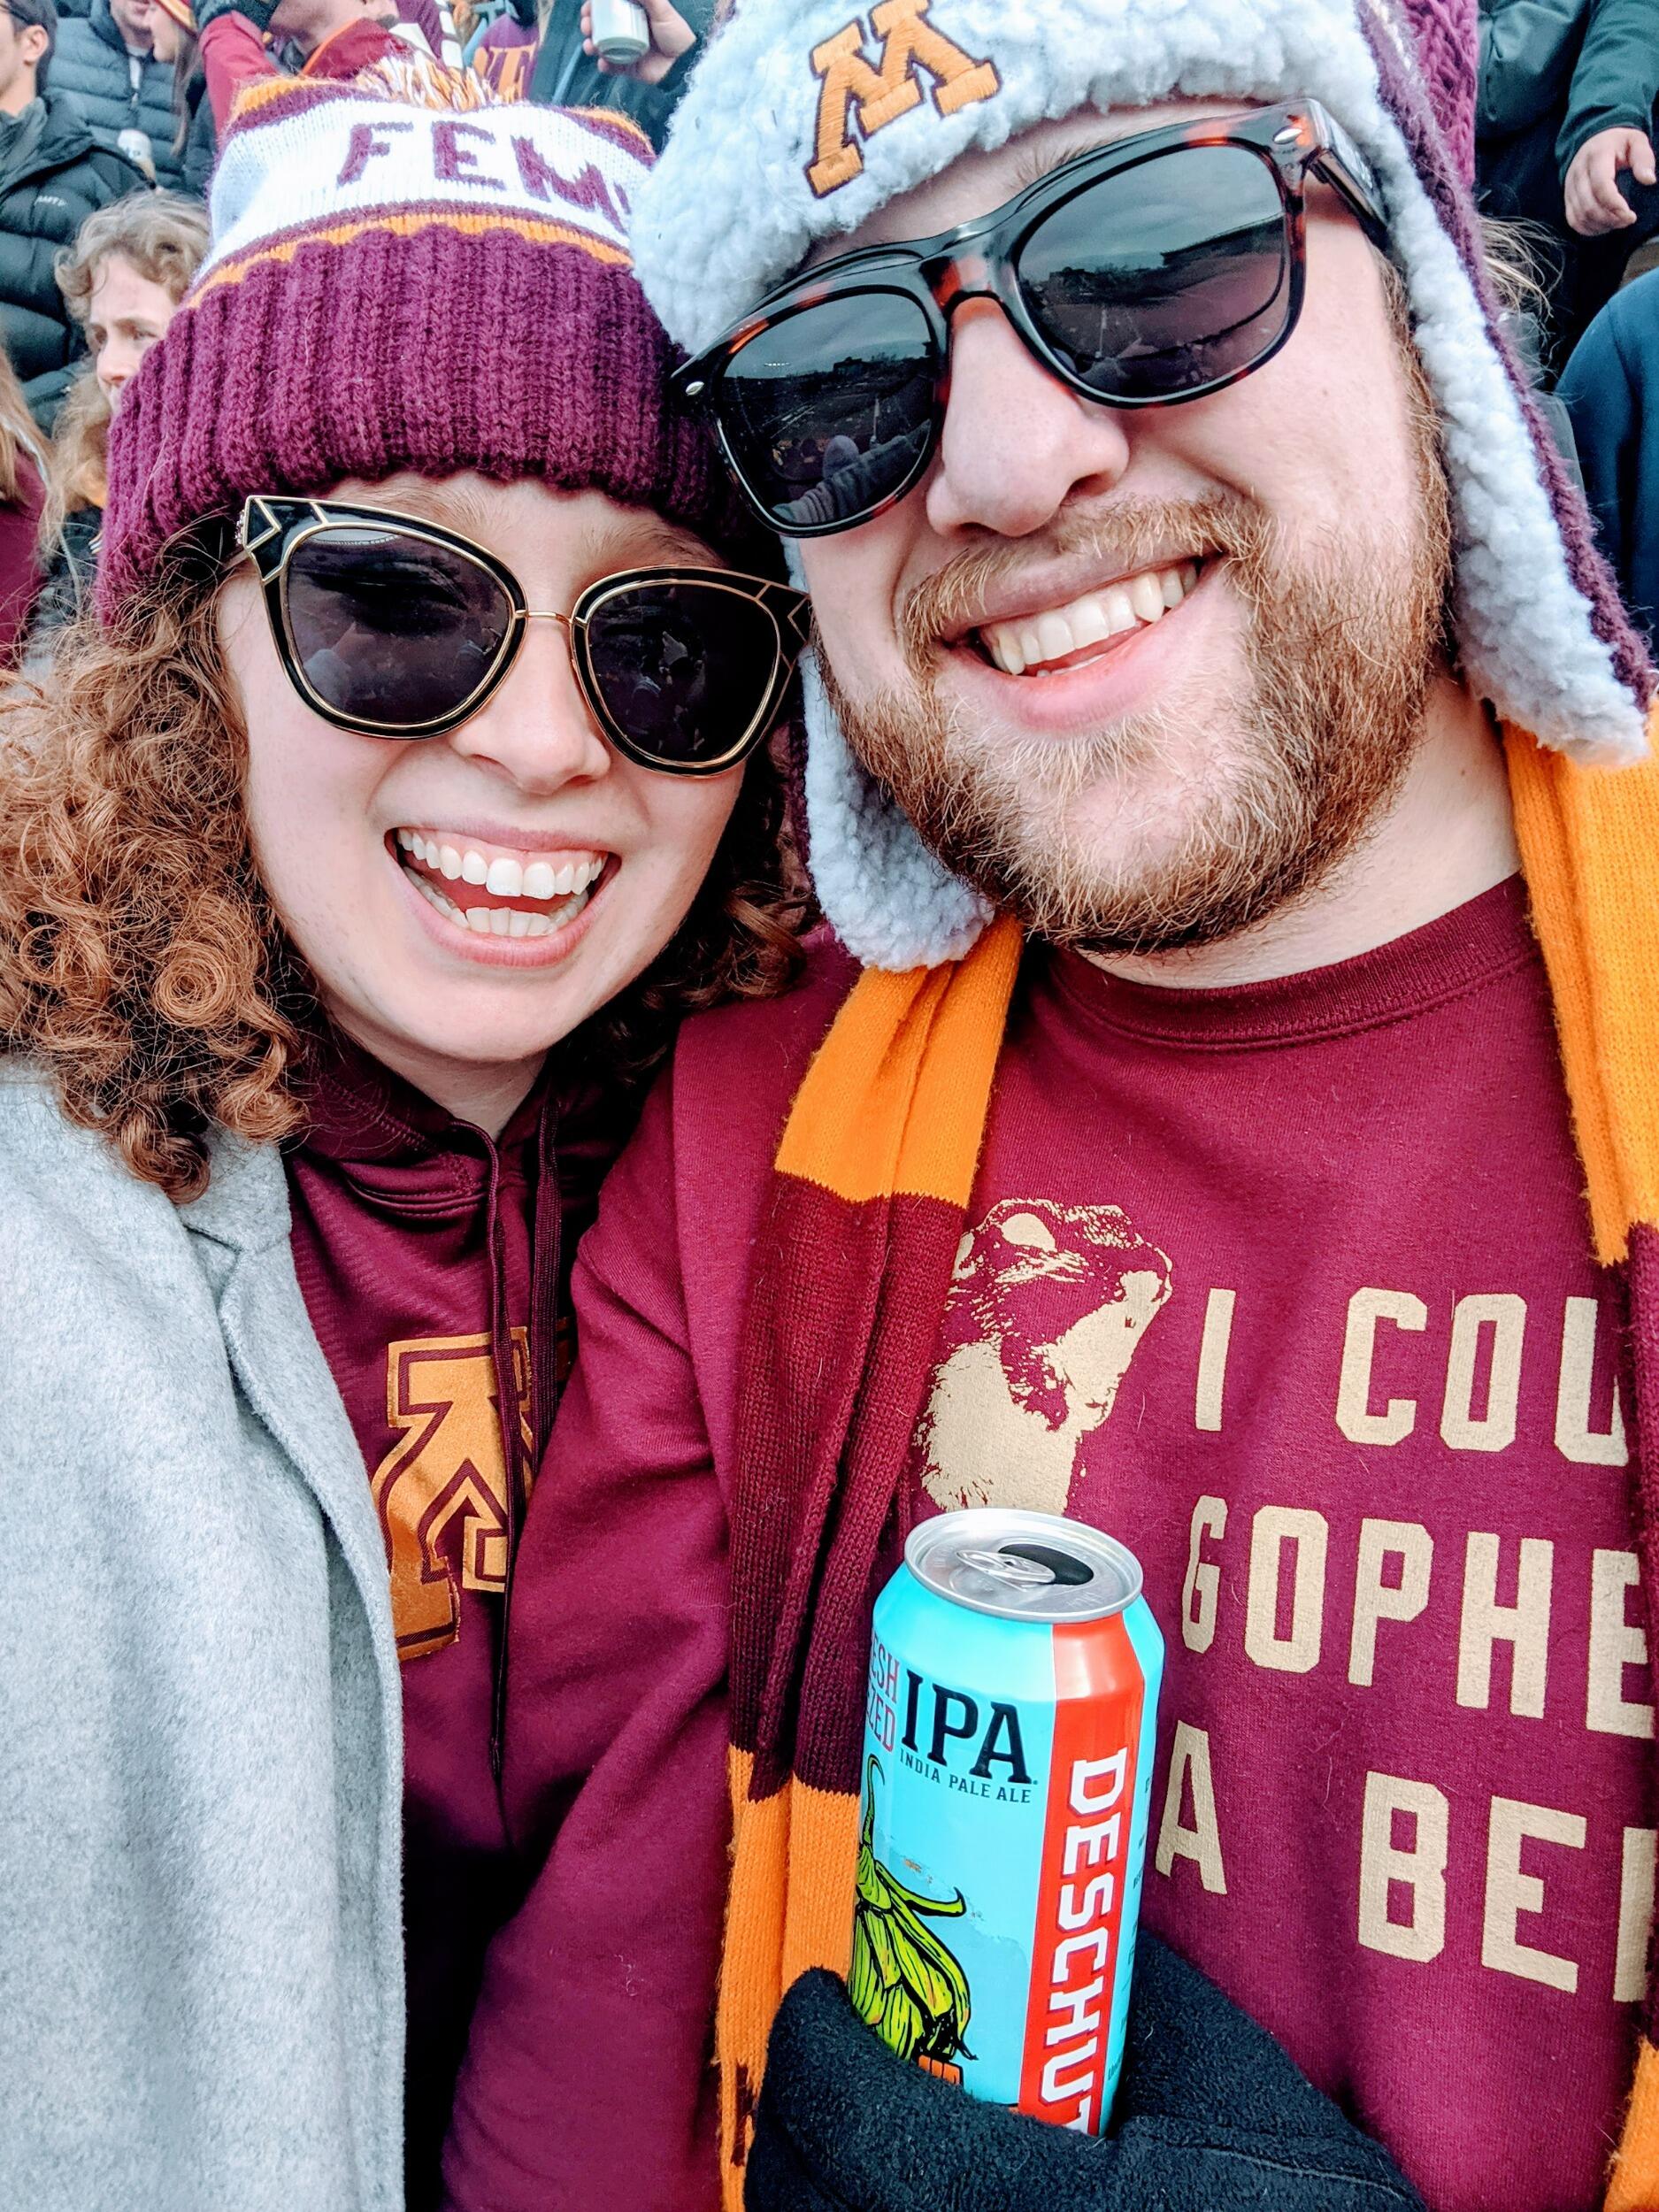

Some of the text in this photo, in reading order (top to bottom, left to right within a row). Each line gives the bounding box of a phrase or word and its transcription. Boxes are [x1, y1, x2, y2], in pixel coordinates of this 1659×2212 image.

[803, 0, 1003, 199] M
[336, 120, 633, 239] FEM
[1194, 1287, 1236, 1432] I
[1182, 1494, 1656, 1740] GOPHE
[899, 1747, 1032, 1804] INDIA PALE ALE
[901, 1668, 1033, 1785] IPA
[1155, 1719, 1227, 1895] A
